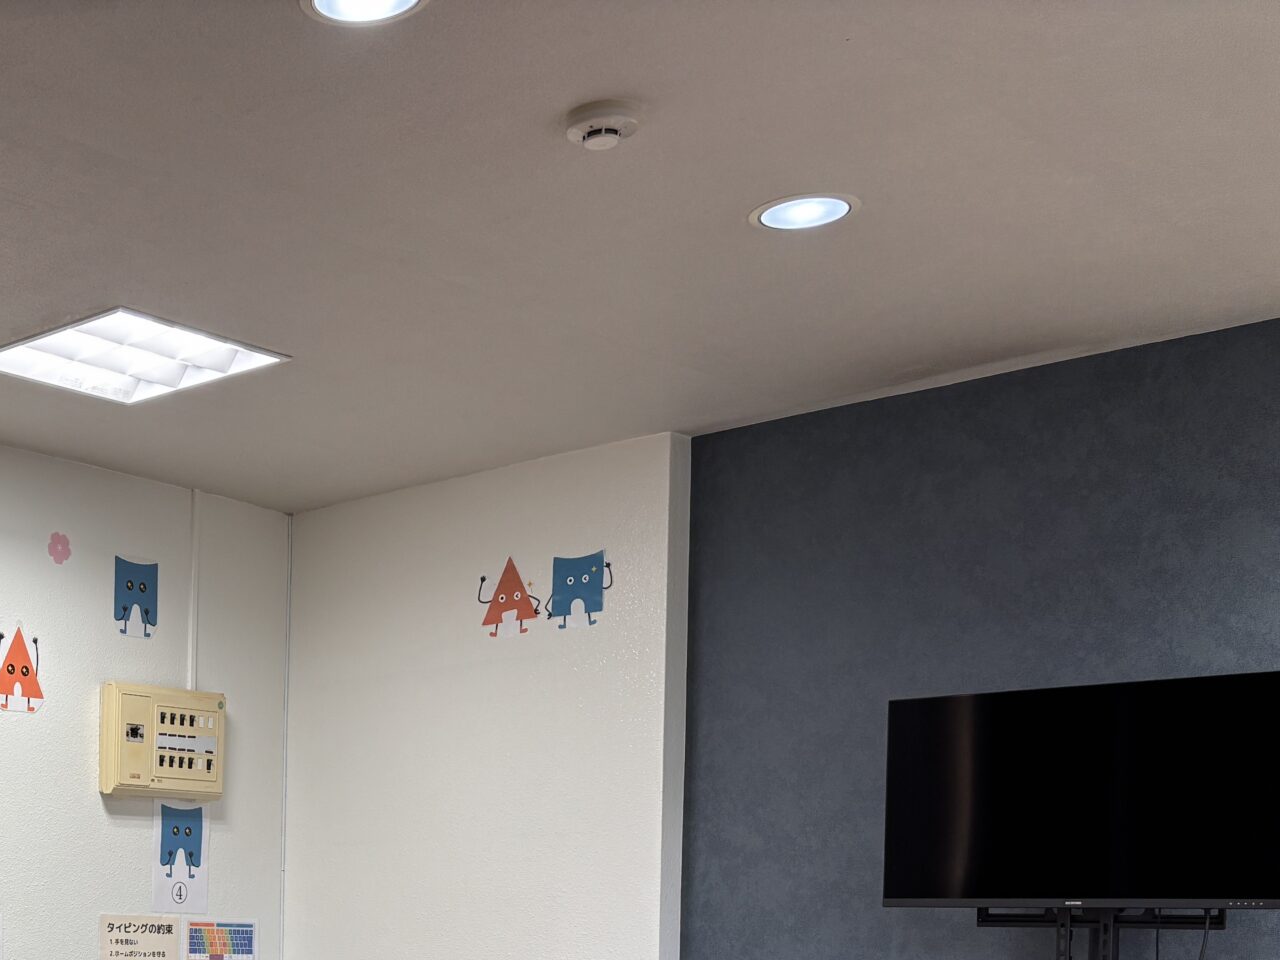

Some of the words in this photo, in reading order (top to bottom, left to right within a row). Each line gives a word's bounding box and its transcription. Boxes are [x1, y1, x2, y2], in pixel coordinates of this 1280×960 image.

[107, 922, 174, 935] タイピングの約束
